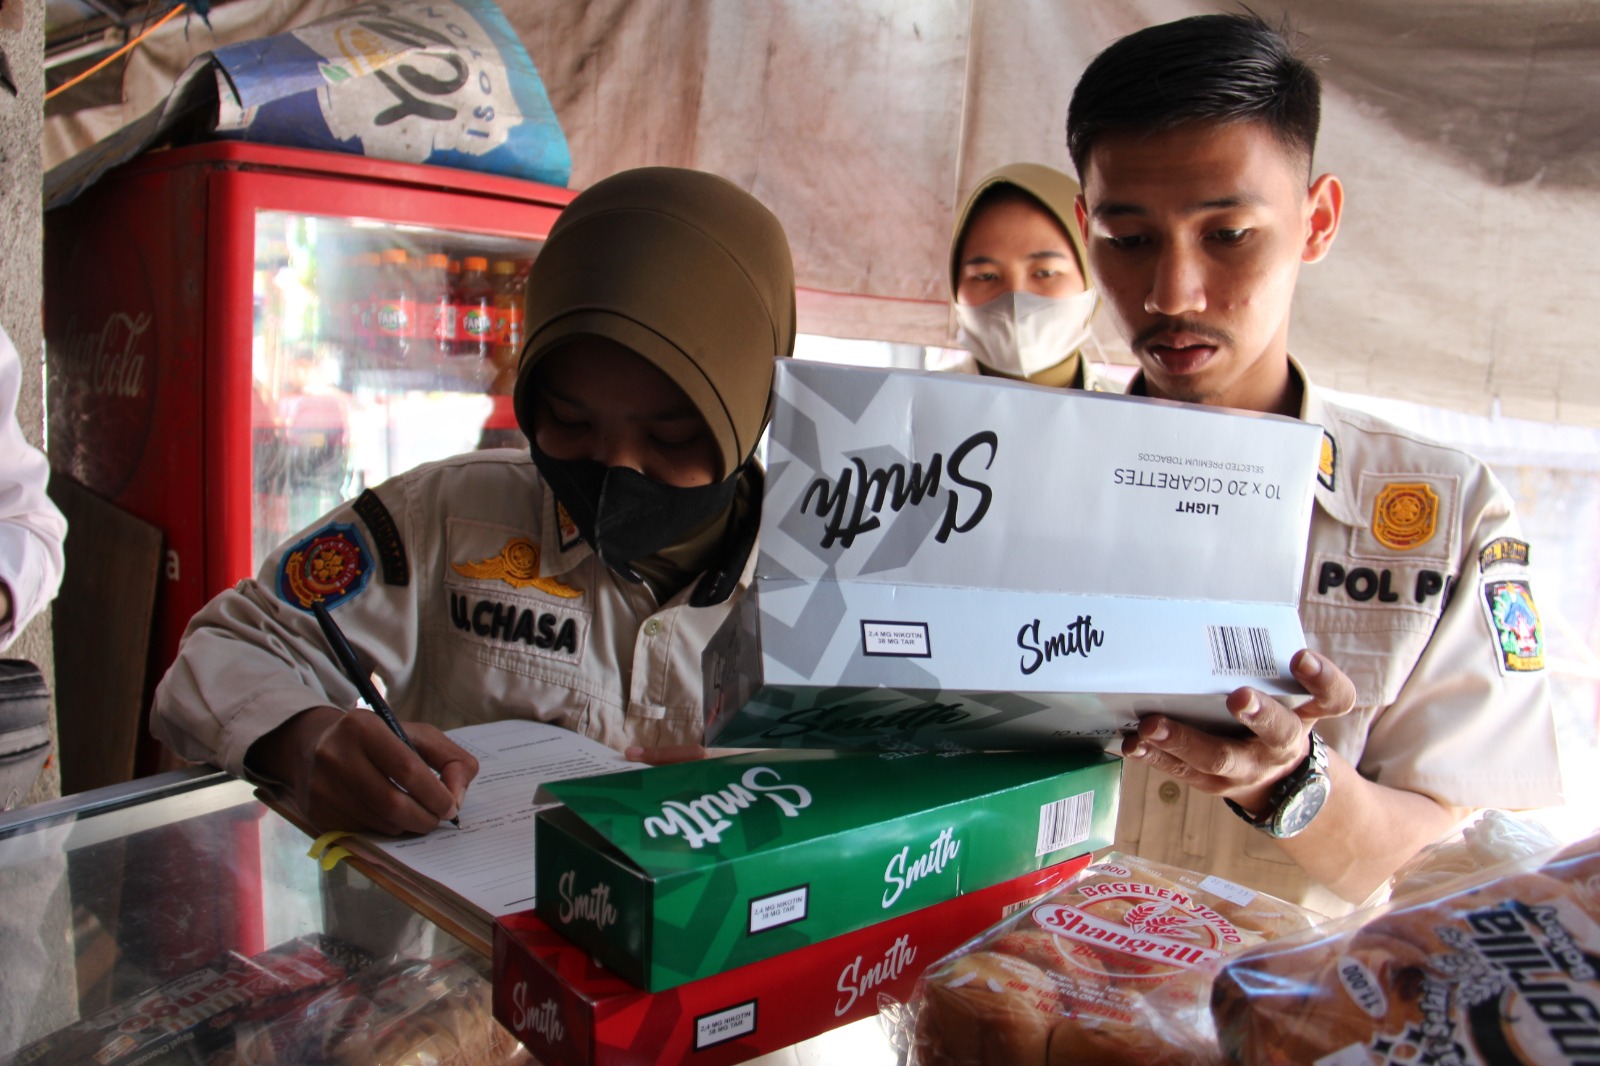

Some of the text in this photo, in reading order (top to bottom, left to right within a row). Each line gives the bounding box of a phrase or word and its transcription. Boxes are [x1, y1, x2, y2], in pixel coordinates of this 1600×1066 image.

[463, 313, 491, 331] FANTA
[1114, 468, 1223, 494] CIGARETTES
[1138, 452, 1265, 474] SELECTED PREMIUM TOBACCOS
[800, 430, 998, 549] Smith
[1175, 501, 1219, 515] LIGHT
[1227, 480, 1248, 496] 20
[1265, 484, 1281, 500] 10
[1318, 561, 1399, 603] POL
[1017, 614, 1104, 675] Smith
[644, 766, 812, 848] Smith
[882, 827, 960, 909] Smith
[558, 870, 617, 931] Smith
[764, 903, 775, 912] MG
[776, 896, 803, 908] NIKOTIN
[770, 909, 781, 917] MG
[782, 904, 795, 914] TAR
[1081, 883, 1242, 944] BAGELEN JUMBO
[1530, 905, 1596, 981] Bakery
[834, 934, 918, 1017] Smith
[1342, 965, 1379, 1009] 11.000
[512, 982, 564, 1045] Smith
[712, 1020, 723, 1029] MG
[724, 1010, 751, 1024] NIKOTIN
[717, 1024, 729, 1033] MG
[730, 1019, 744, 1029] TAR
